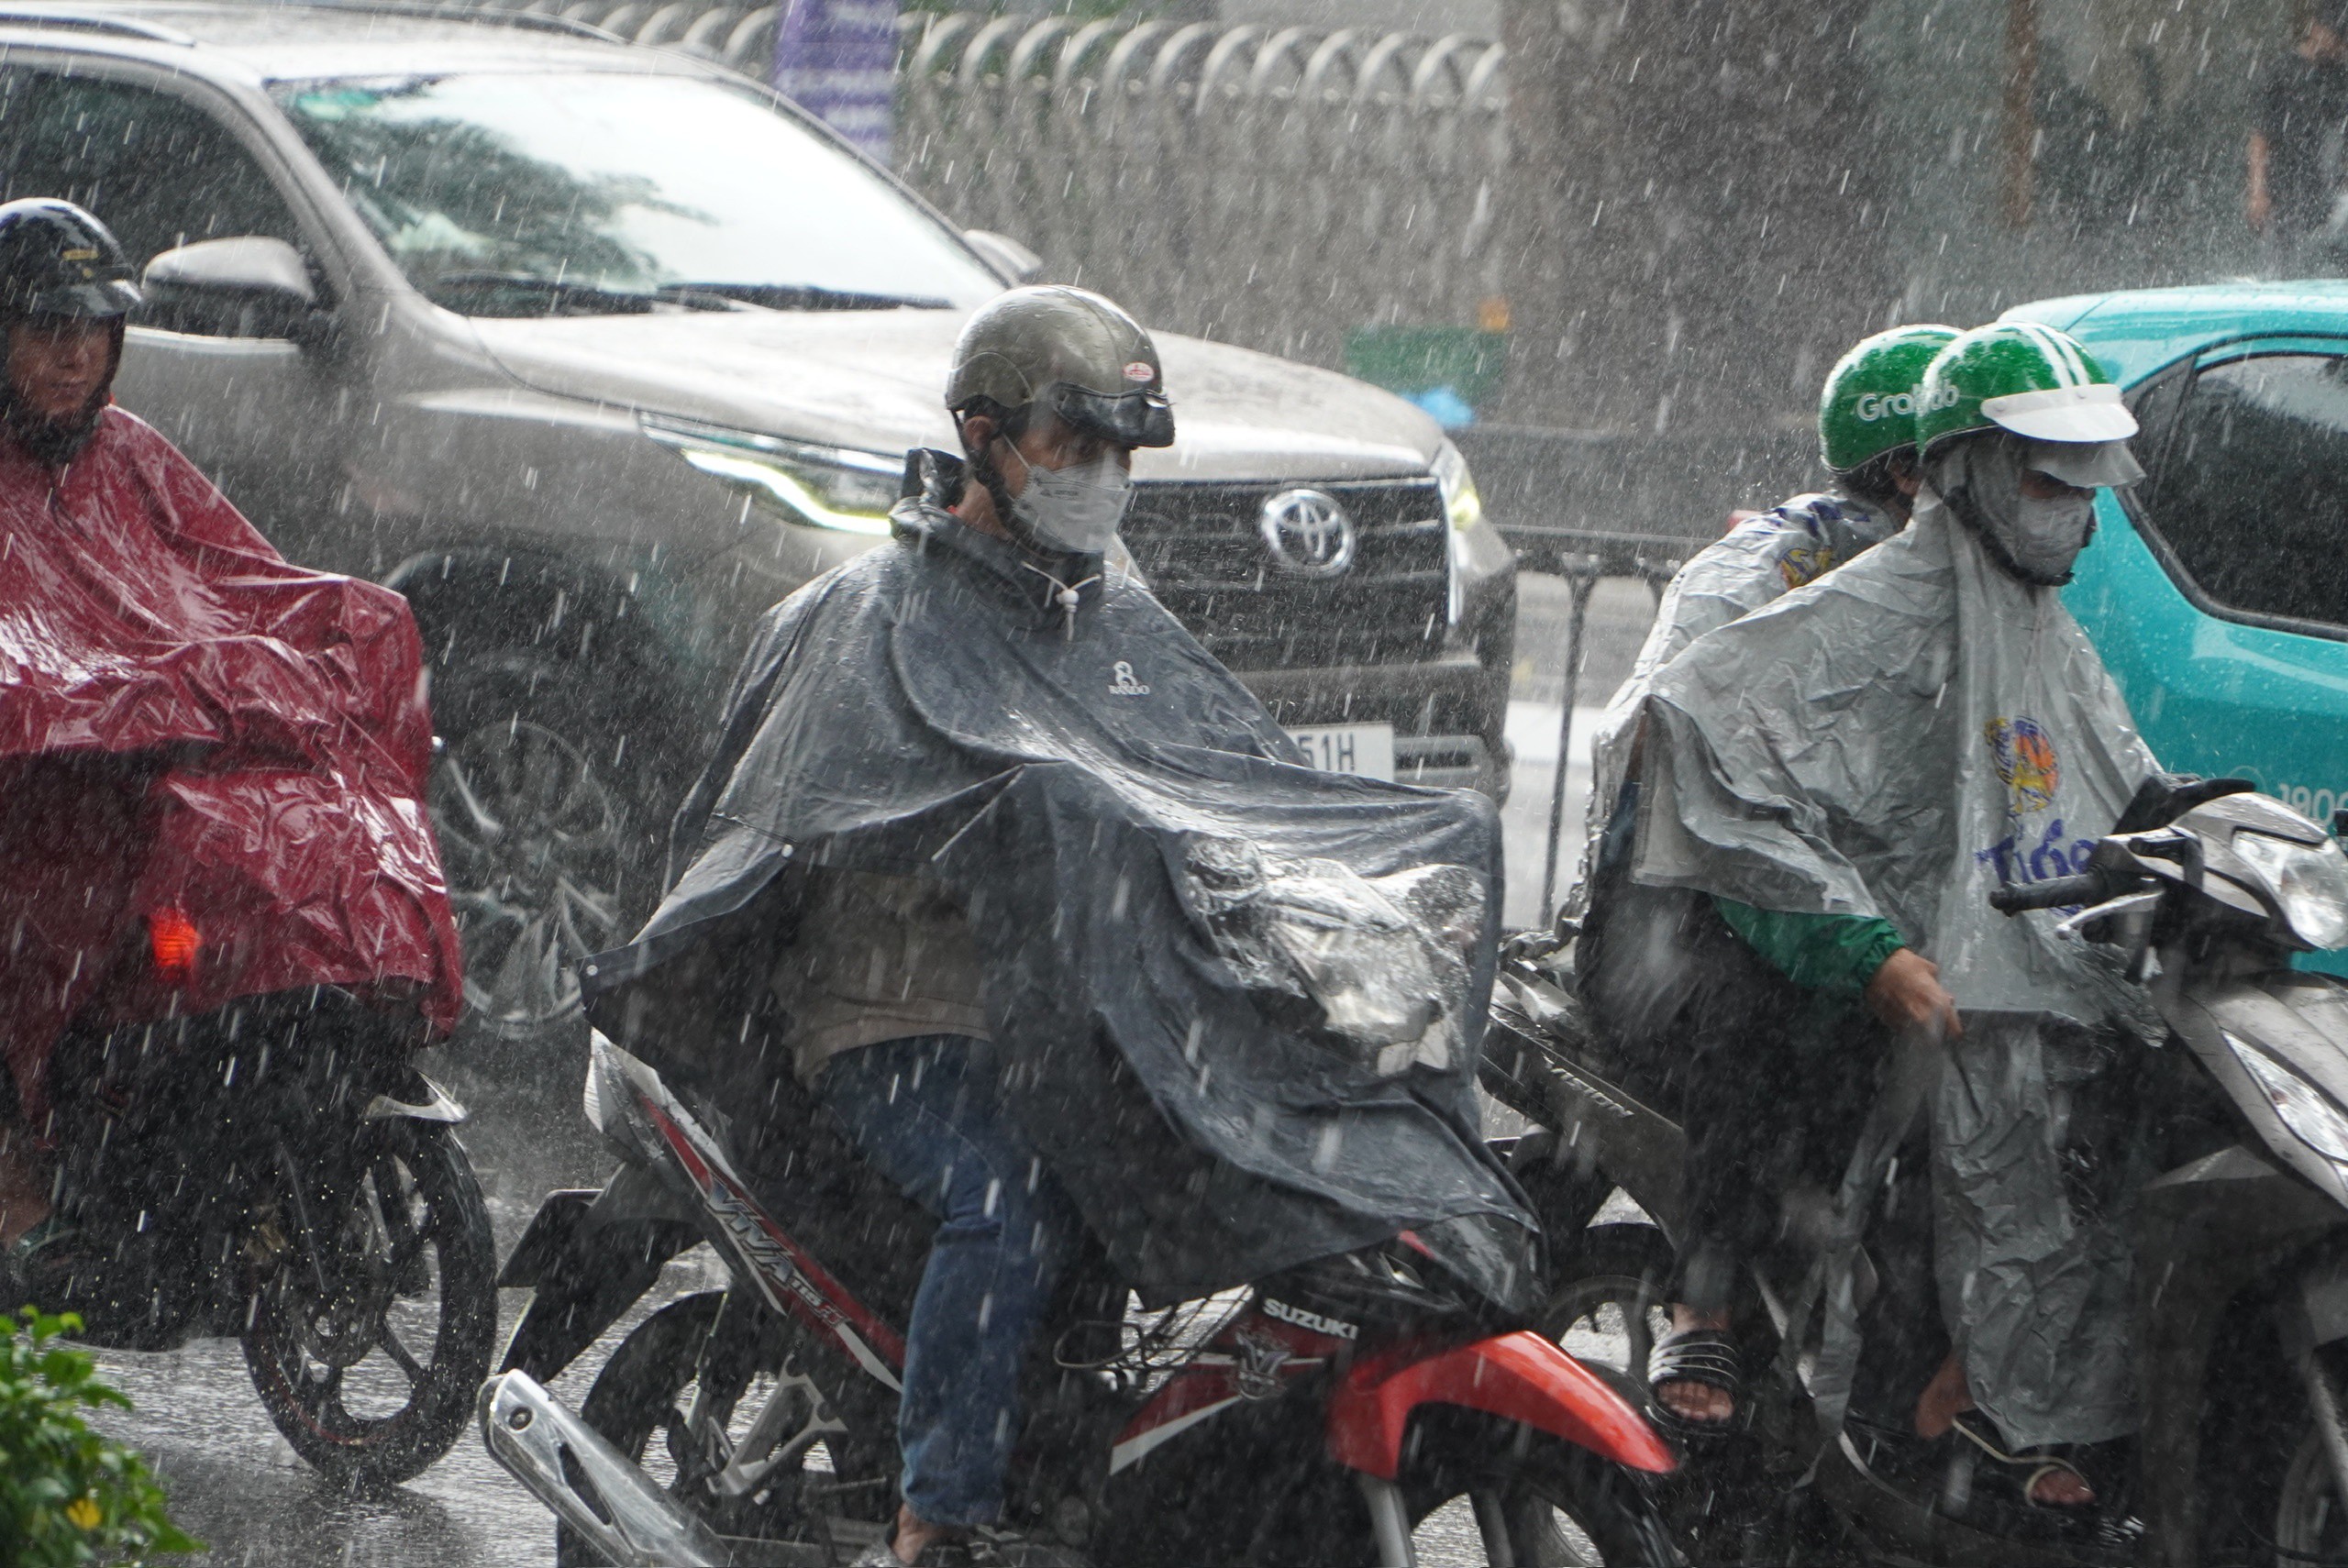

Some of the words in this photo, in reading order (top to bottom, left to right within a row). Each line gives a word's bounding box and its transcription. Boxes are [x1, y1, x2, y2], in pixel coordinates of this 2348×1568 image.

[1298, 733, 1355, 772] 51H
[706, 1174, 792, 1285] VIVA
[1263, 1297, 1358, 1340] SUZUKI
